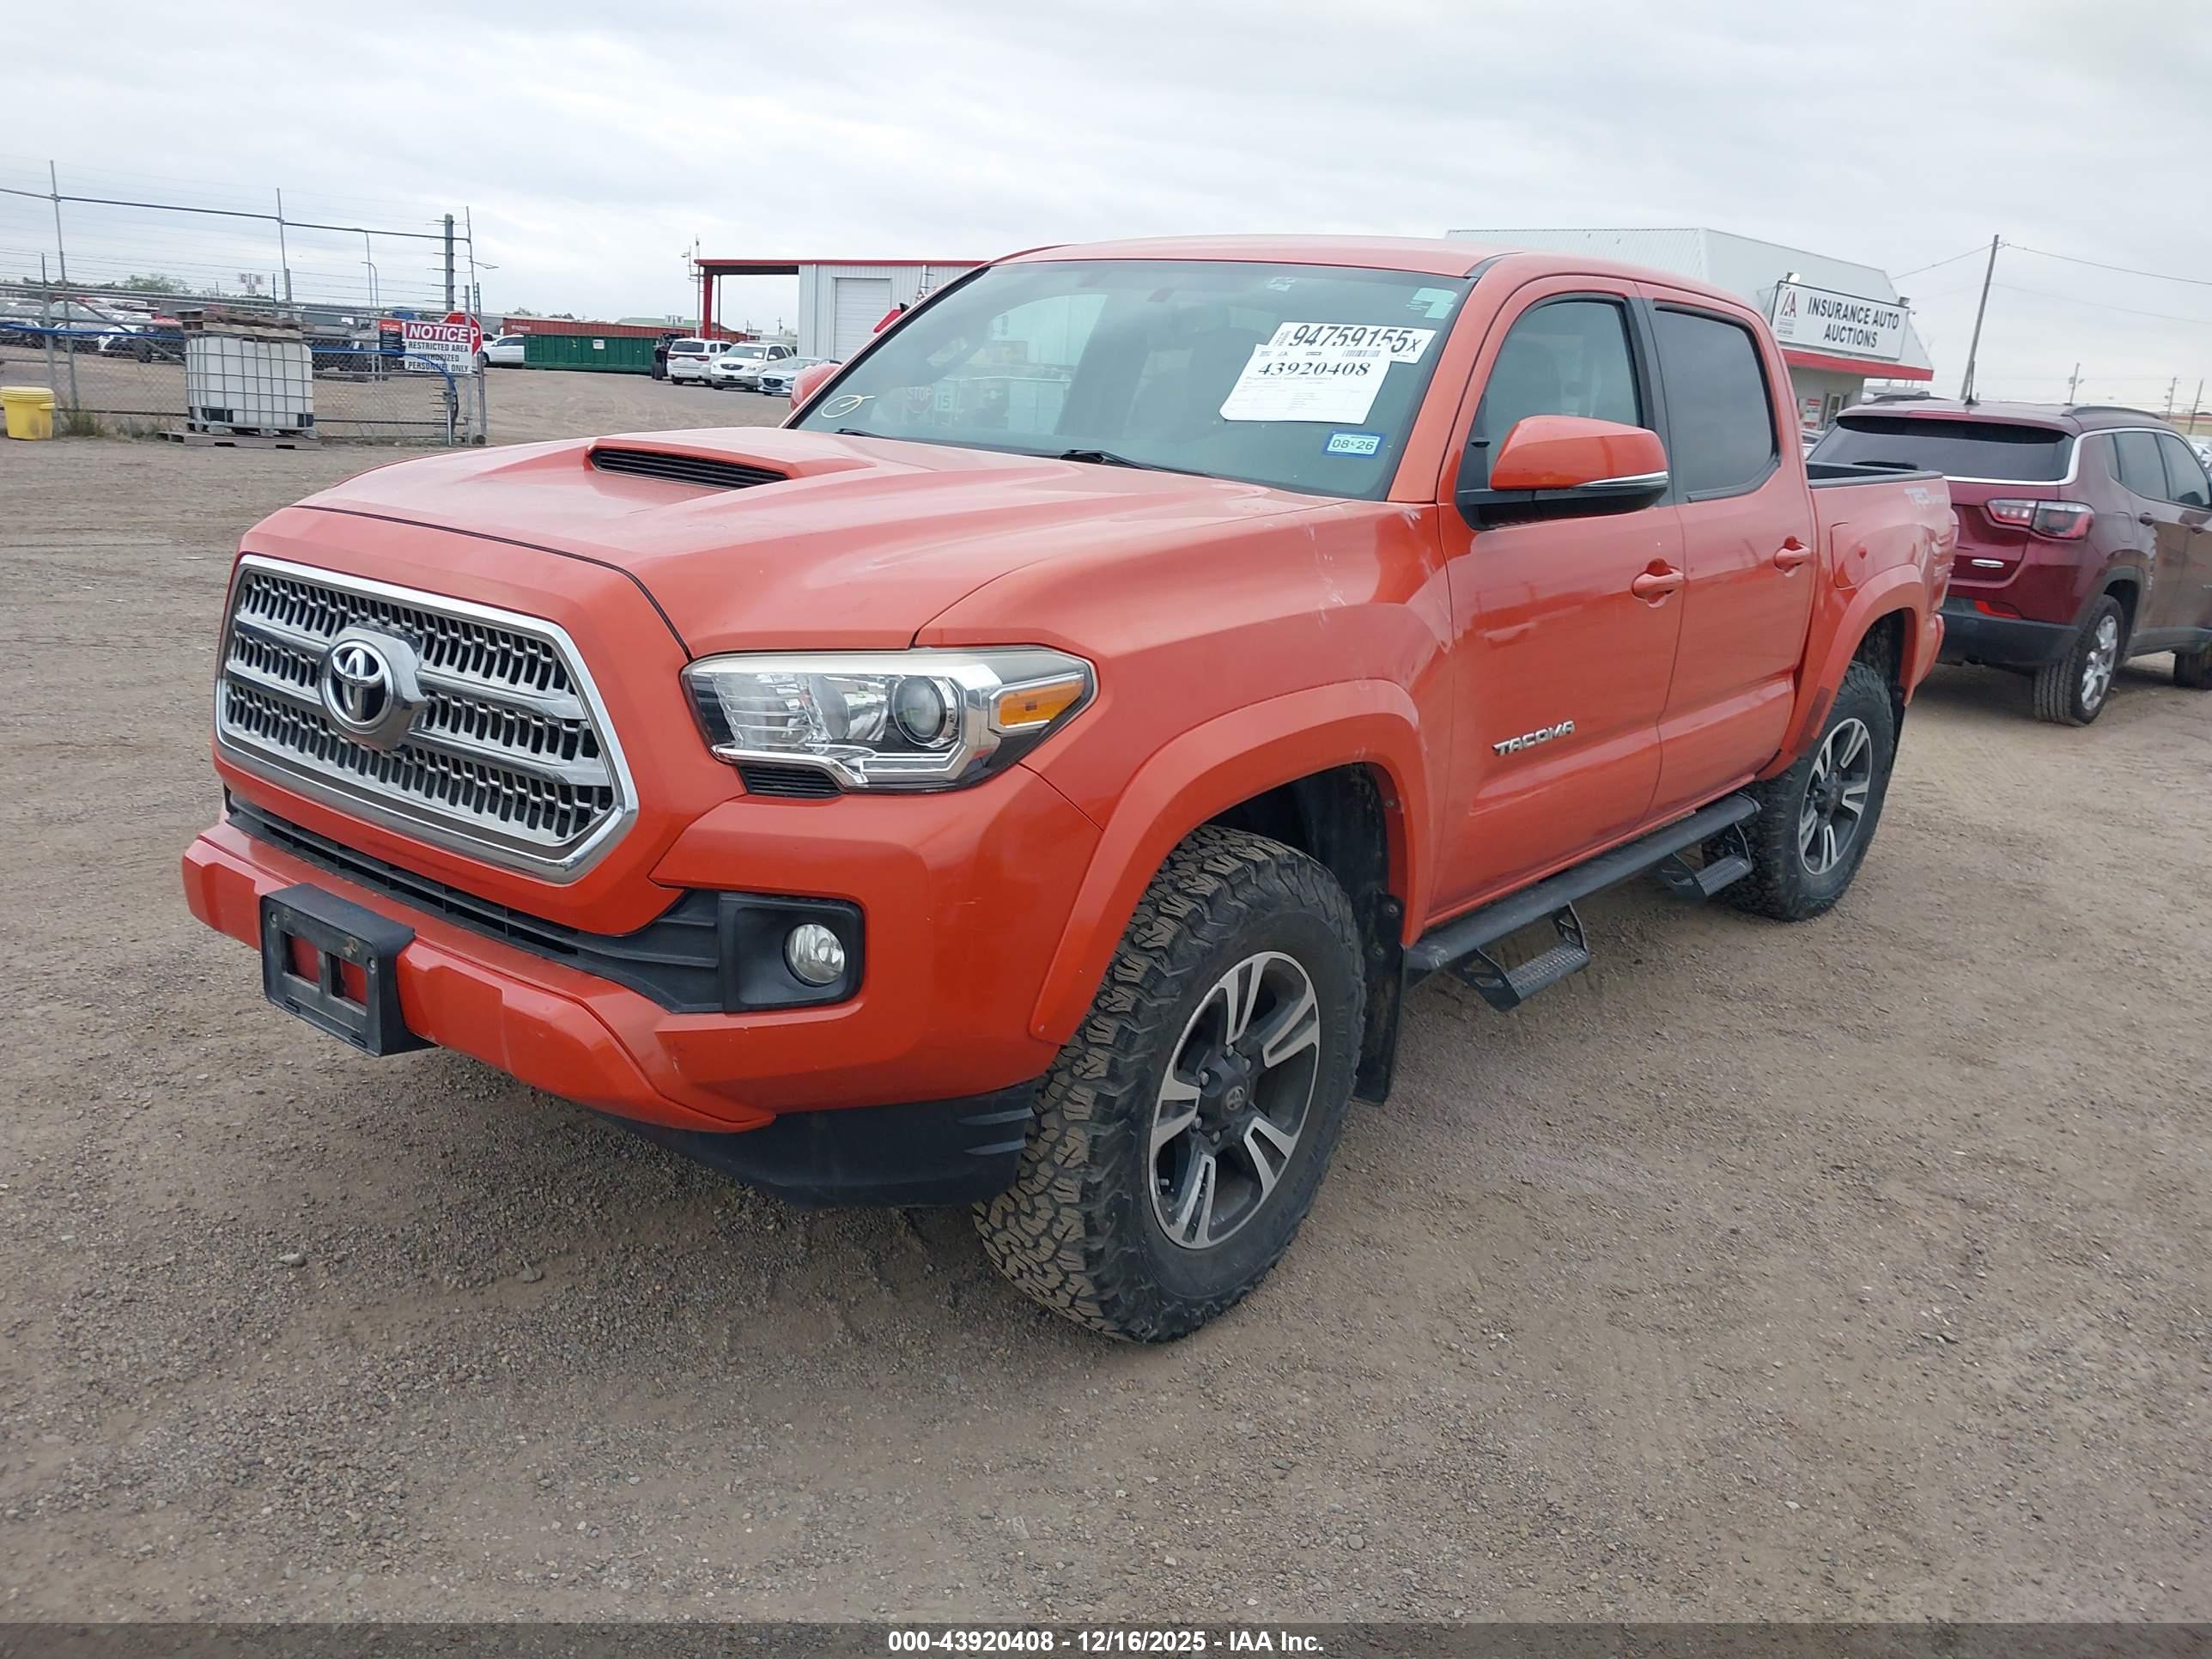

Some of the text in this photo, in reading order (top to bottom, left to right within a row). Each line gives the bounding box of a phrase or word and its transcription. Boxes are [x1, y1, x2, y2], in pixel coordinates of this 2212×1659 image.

[1807, 296, 1871, 325] INSURANCE
[1871, 309, 1899, 331] AUTO
[408, 324, 469, 343] NOTICE
[1823, 322, 1878, 349] AUCTIONS
[408, 341, 469, 353] RESTRICTED AREA
[451, 363, 469, 373] ONLY
[1258, 362, 1371, 376] 43920408
[1492, 720, 1576, 757] TACOMA
